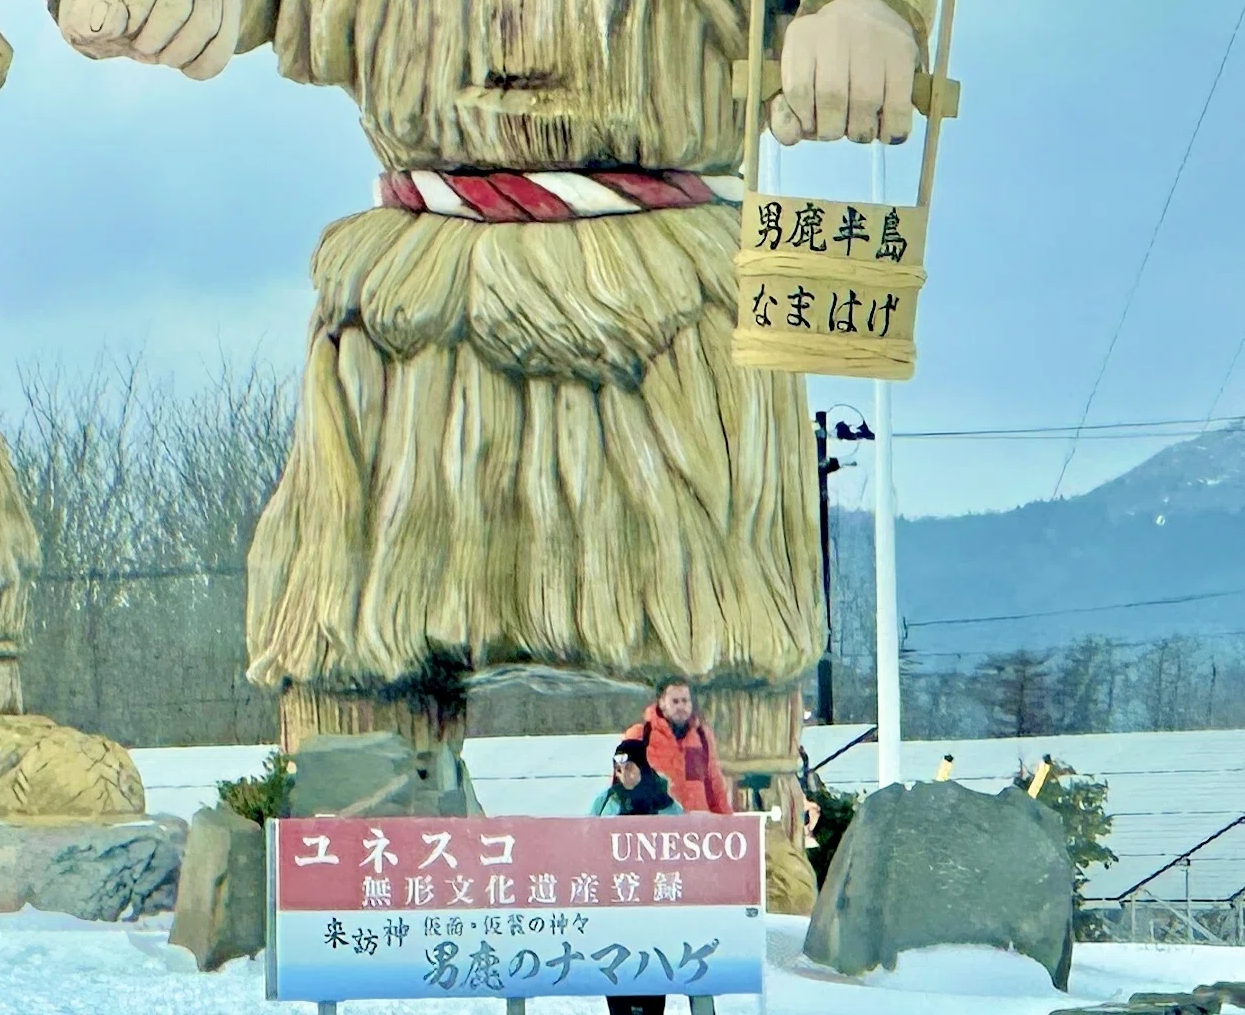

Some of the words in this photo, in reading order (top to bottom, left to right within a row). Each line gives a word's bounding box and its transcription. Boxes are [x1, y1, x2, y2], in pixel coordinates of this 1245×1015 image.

[755, 201, 908, 262] 男鹿半島
[752, 283, 900, 337] なまはげ
[294, 830, 516, 874] ユネスコ
[610, 831, 748, 862] UNESCO
[361, 874, 683, 907] 無形文化遺産登録
[324, 916, 410, 956] 来訪神
[422, 938, 720, 991] 男鹿のナマハゲ
